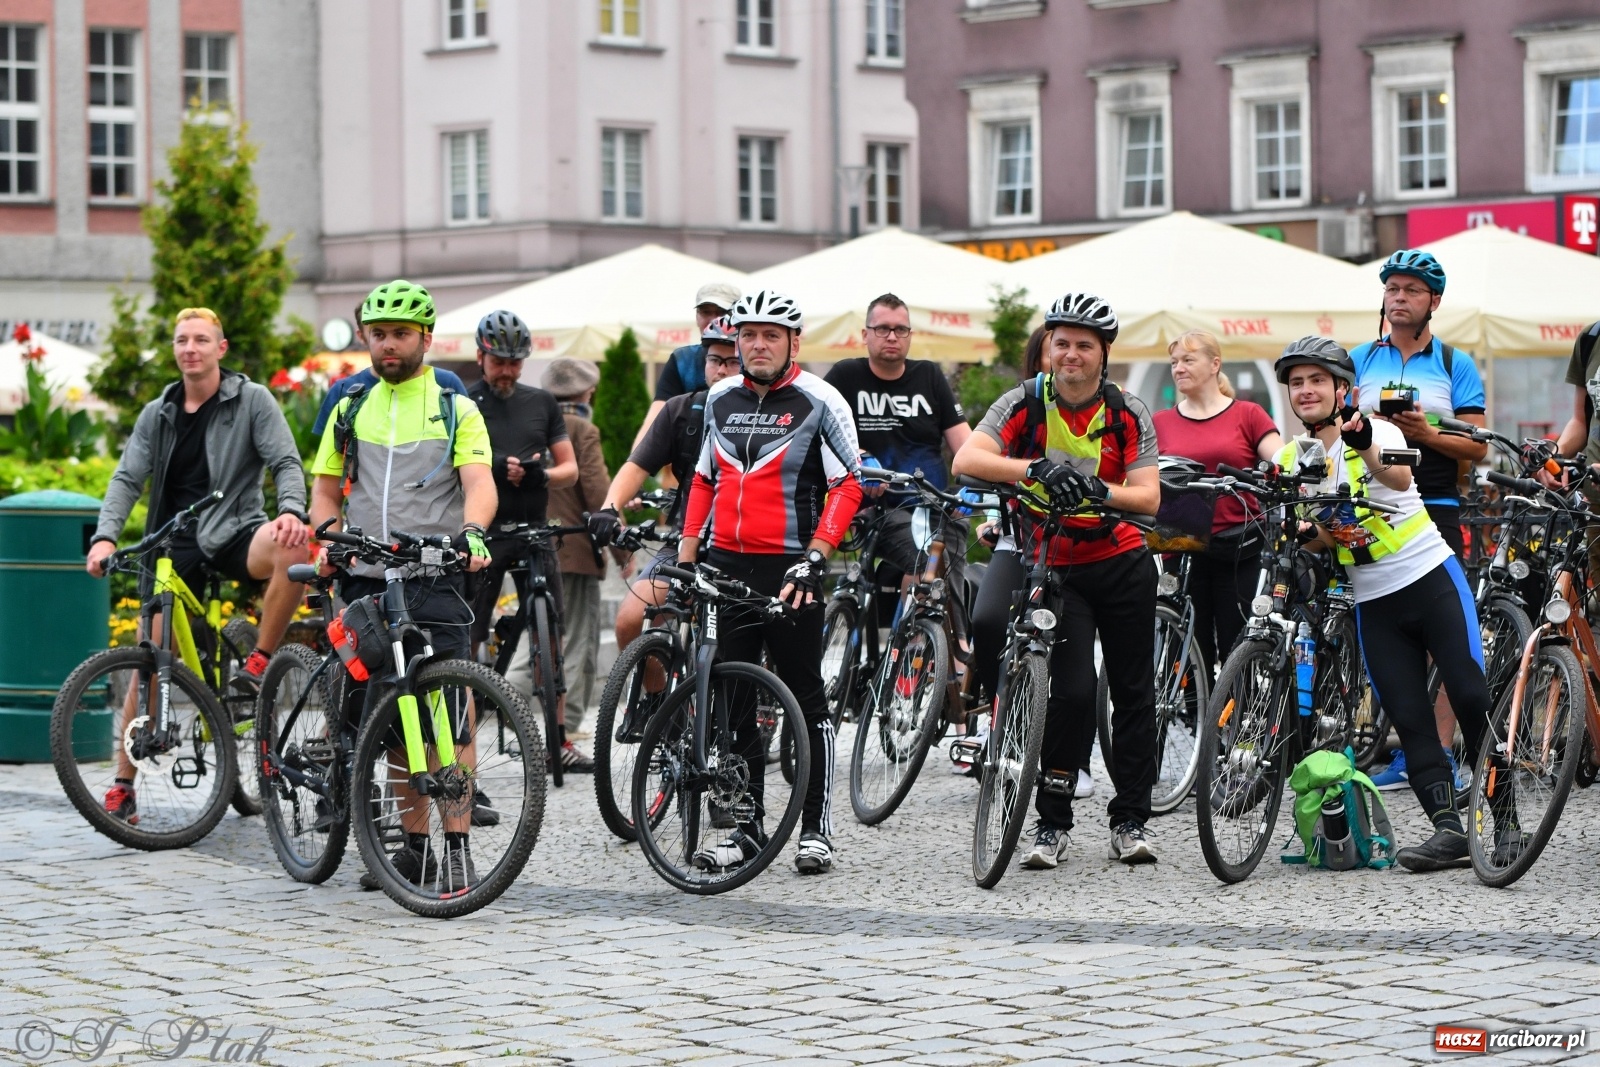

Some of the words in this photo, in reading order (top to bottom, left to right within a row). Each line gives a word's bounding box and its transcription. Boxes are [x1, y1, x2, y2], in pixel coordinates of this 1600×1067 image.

[1573, 202, 1597, 245] T
[929, 311, 971, 327] TYSKIE
[1220, 319, 1272, 336] TYSKIE
[857, 389, 933, 418] NASA
[726, 413, 778, 425] AGU
[706, 603, 717, 640] BMC
